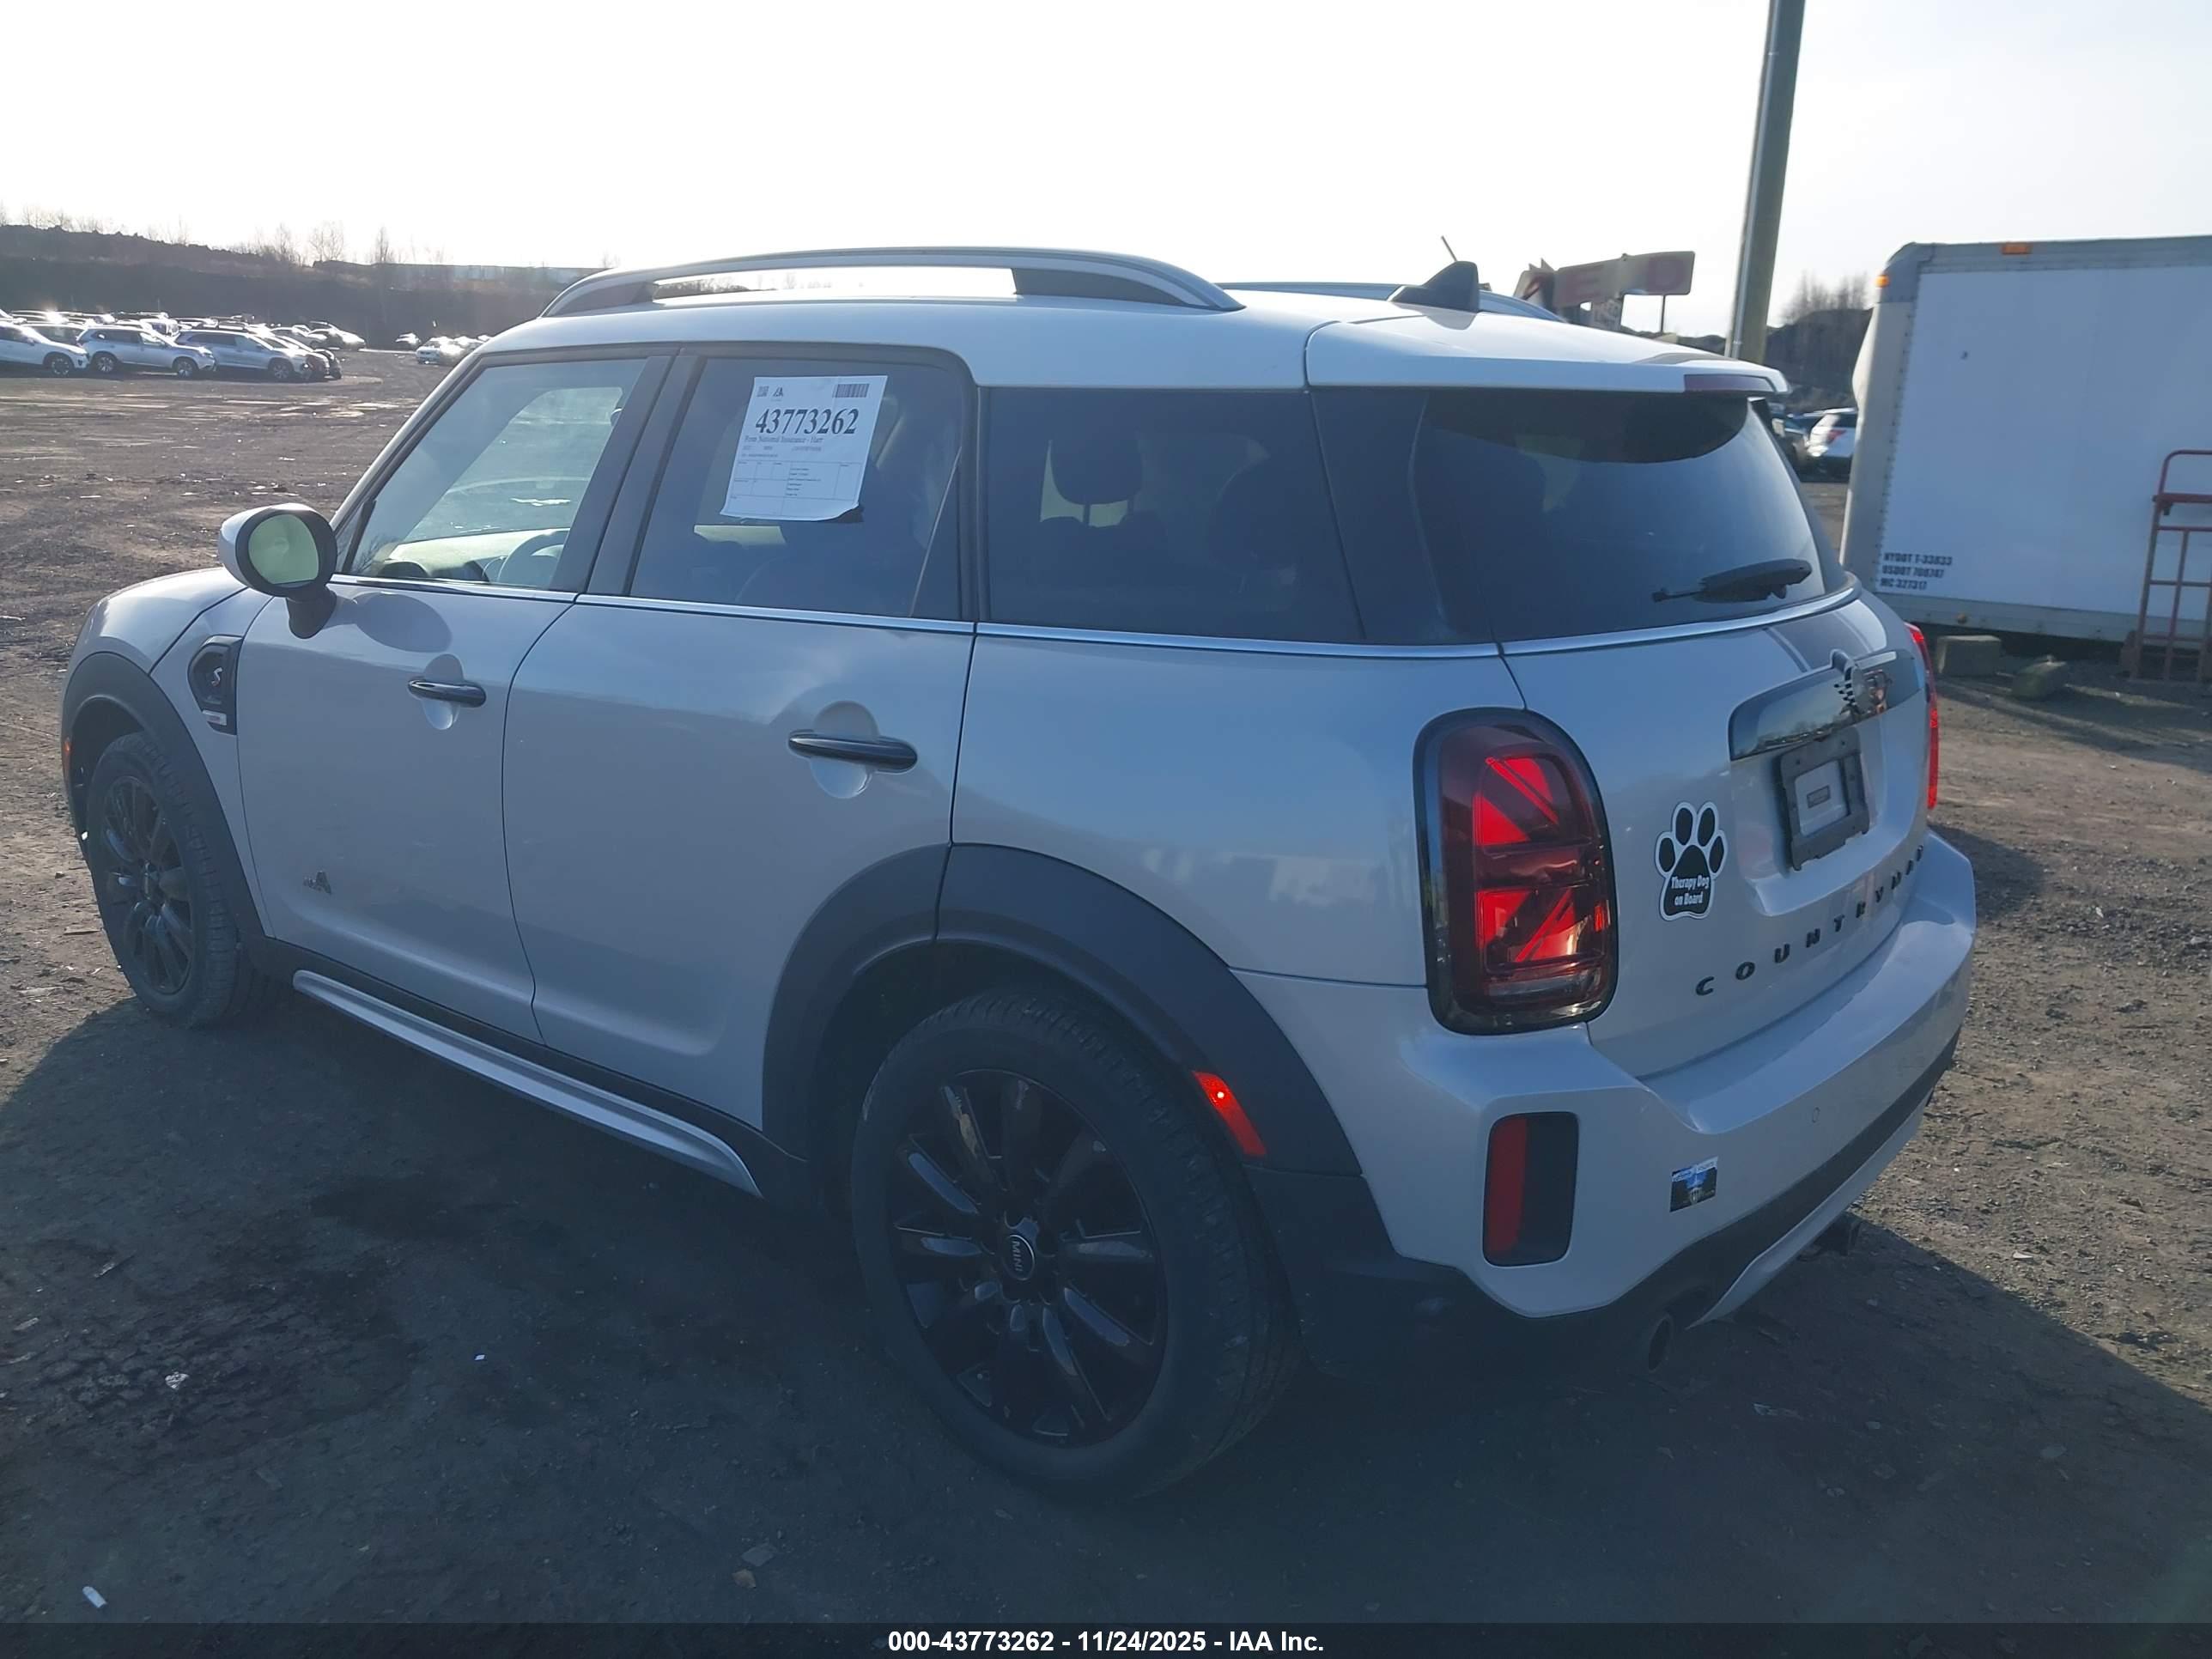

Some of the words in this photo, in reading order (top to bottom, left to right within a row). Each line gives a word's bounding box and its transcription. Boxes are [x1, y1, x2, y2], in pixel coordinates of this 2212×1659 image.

[756, 408, 860, 434] 43773262
[1671, 877, 1698, 890] Therapy
[1697, 875, 1710, 890] Dog
[1674, 896, 1684, 906] on
[1684, 891, 1704, 904] Board
[1012, 1241, 1023, 1272] MINI
